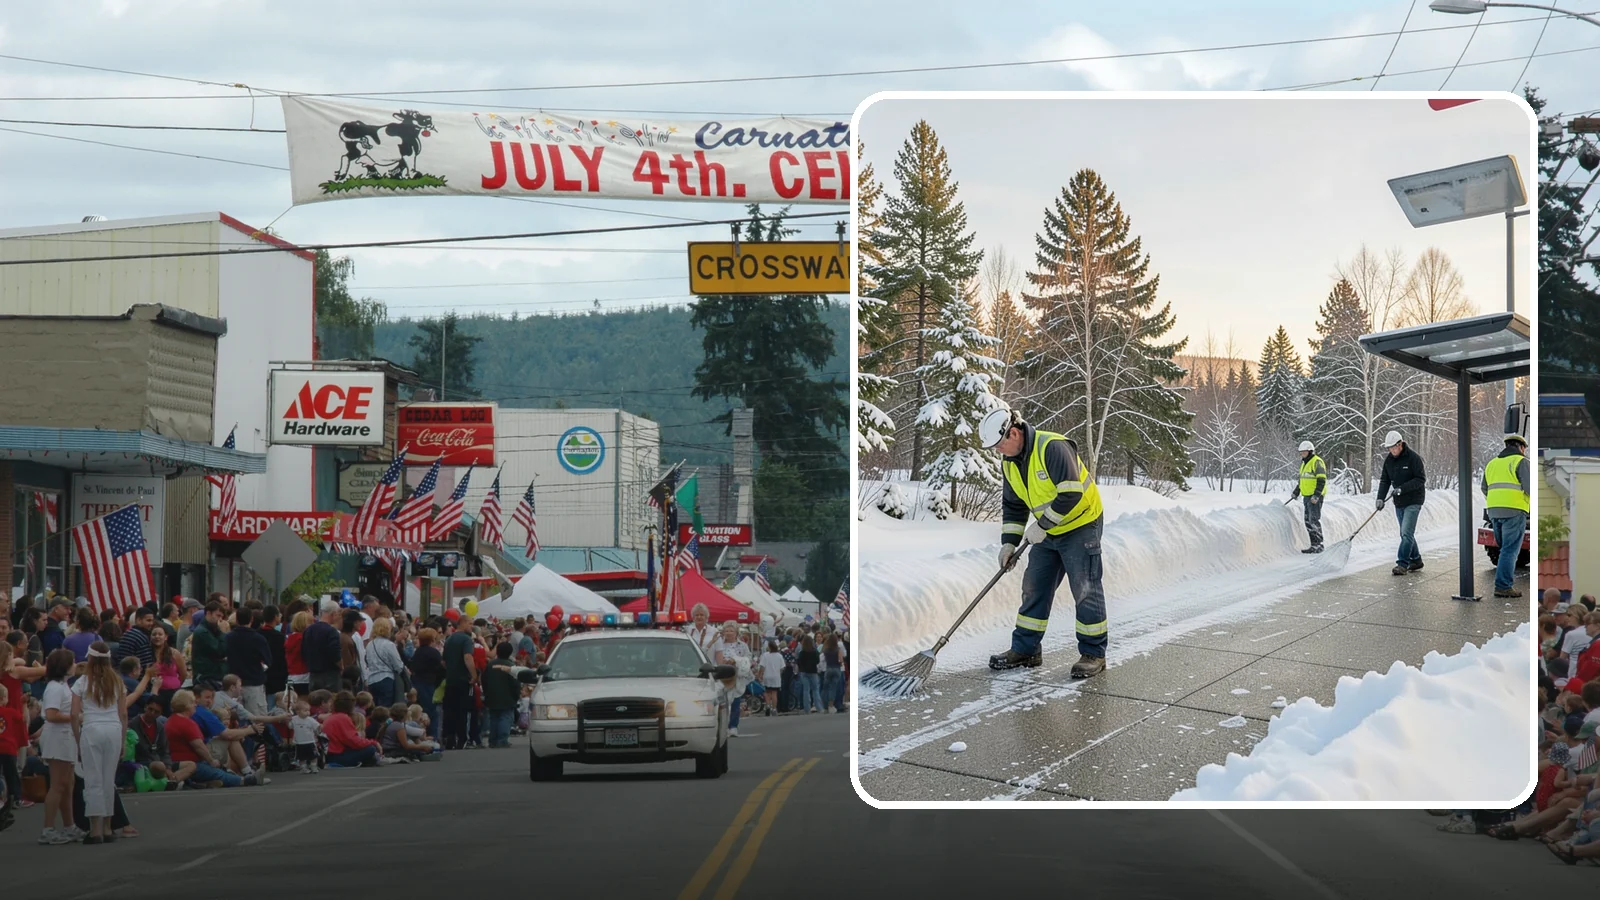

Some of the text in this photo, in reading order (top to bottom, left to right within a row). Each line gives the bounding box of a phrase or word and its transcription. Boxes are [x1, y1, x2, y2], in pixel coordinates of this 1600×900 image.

[481, 141, 605, 192] JULY
[632, 150, 746, 197] 4th.
[697, 255, 850, 279] CROSSWA
[283, 380, 373, 419] ACE
[406, 410, 452, 421] CEDAR
[283, 421, 370, 436] Hardware
[416, 428, 477, 446] Coca-Cola
[83, 485, 155, 495] St. Vincent de Paul
[688, 526, 741, 535] CRNATION
[699, 535, 730, 543] GLASS
